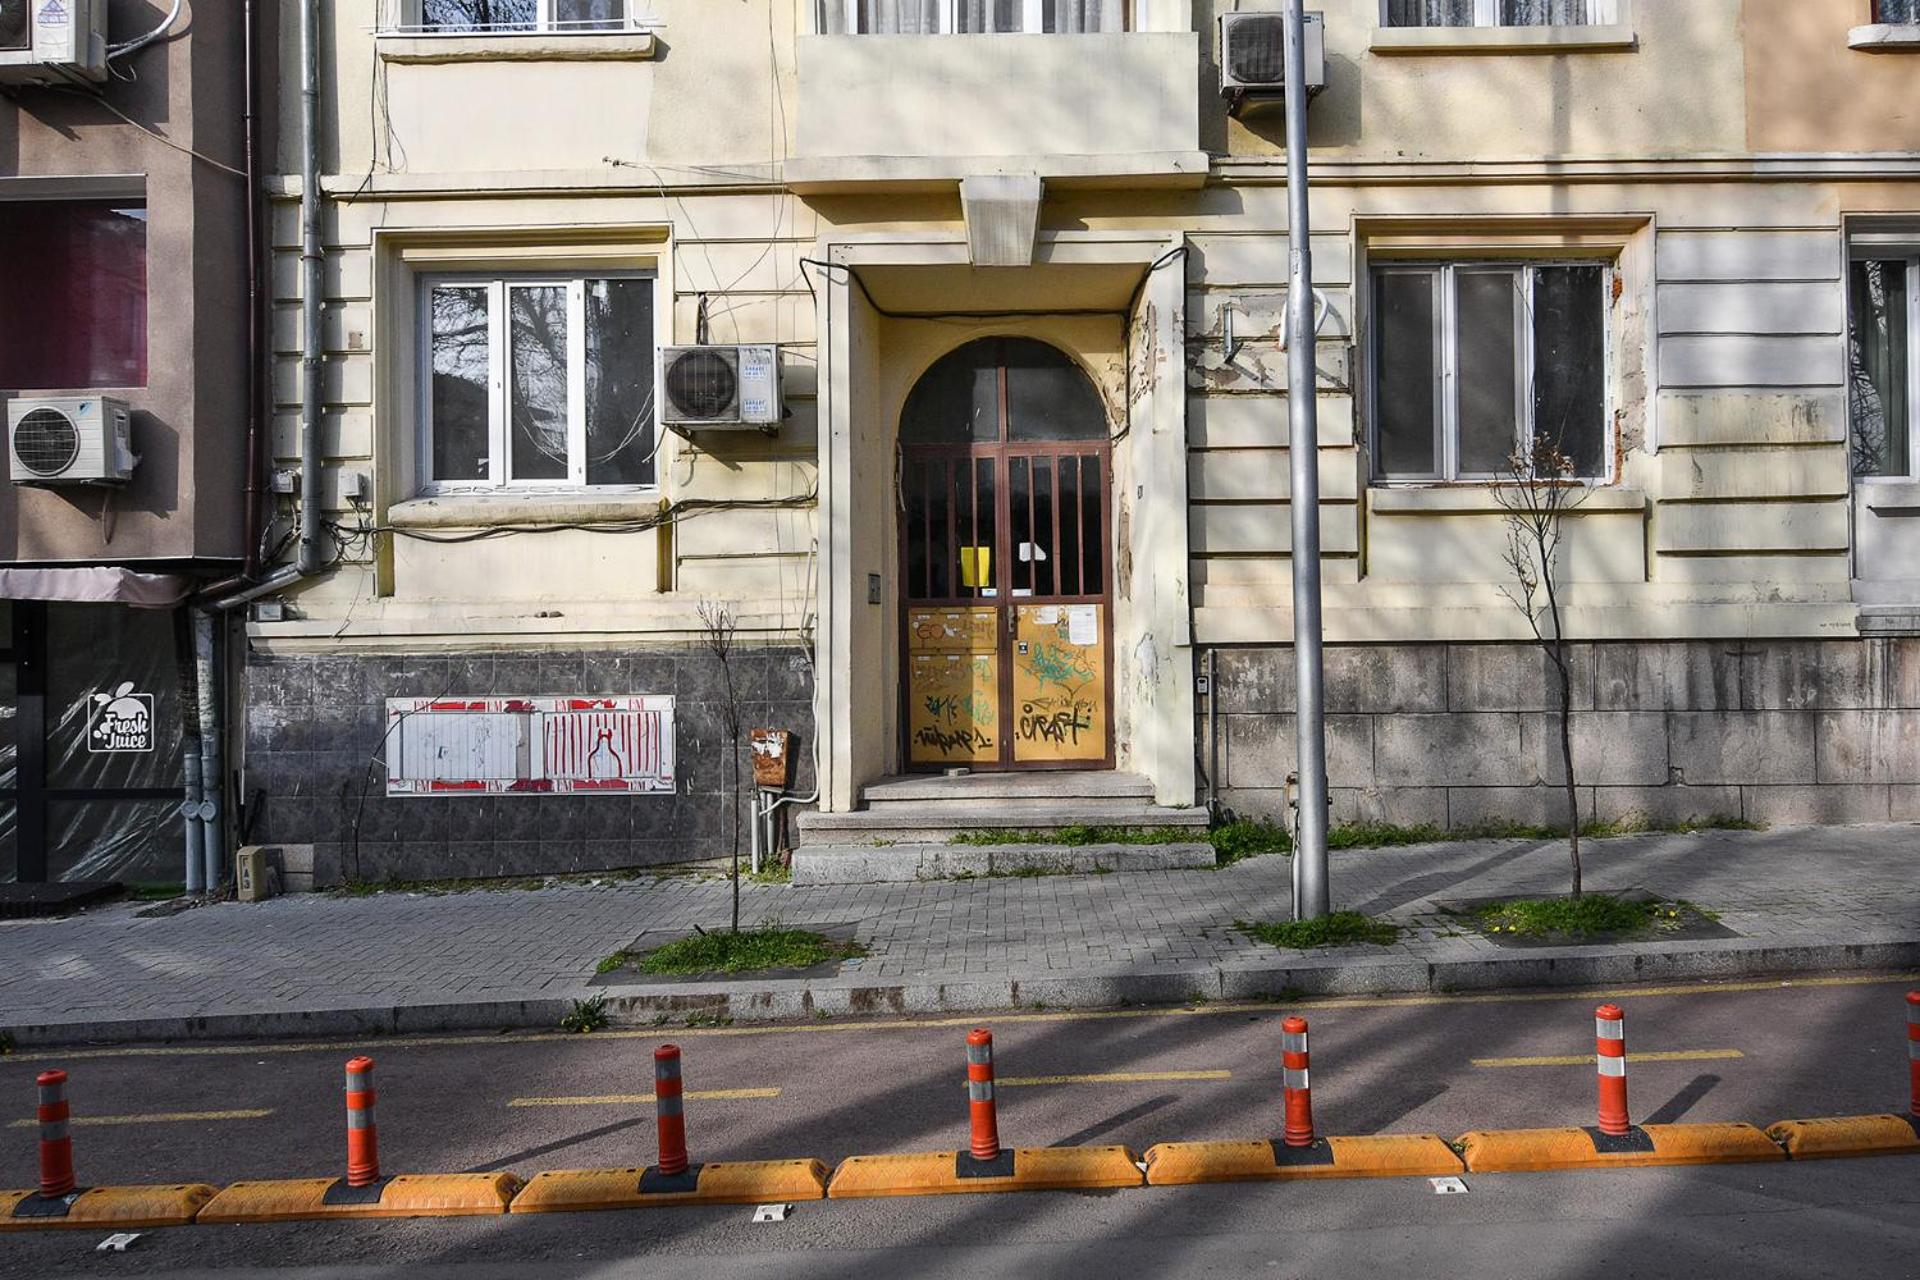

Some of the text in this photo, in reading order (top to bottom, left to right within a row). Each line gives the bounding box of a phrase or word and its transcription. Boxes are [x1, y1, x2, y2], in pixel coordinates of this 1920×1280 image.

[103, 712, 149, 734] Fresh
[104, 731, 147, 749] Juice
[242, 856, 251, 890] ГАЗ
